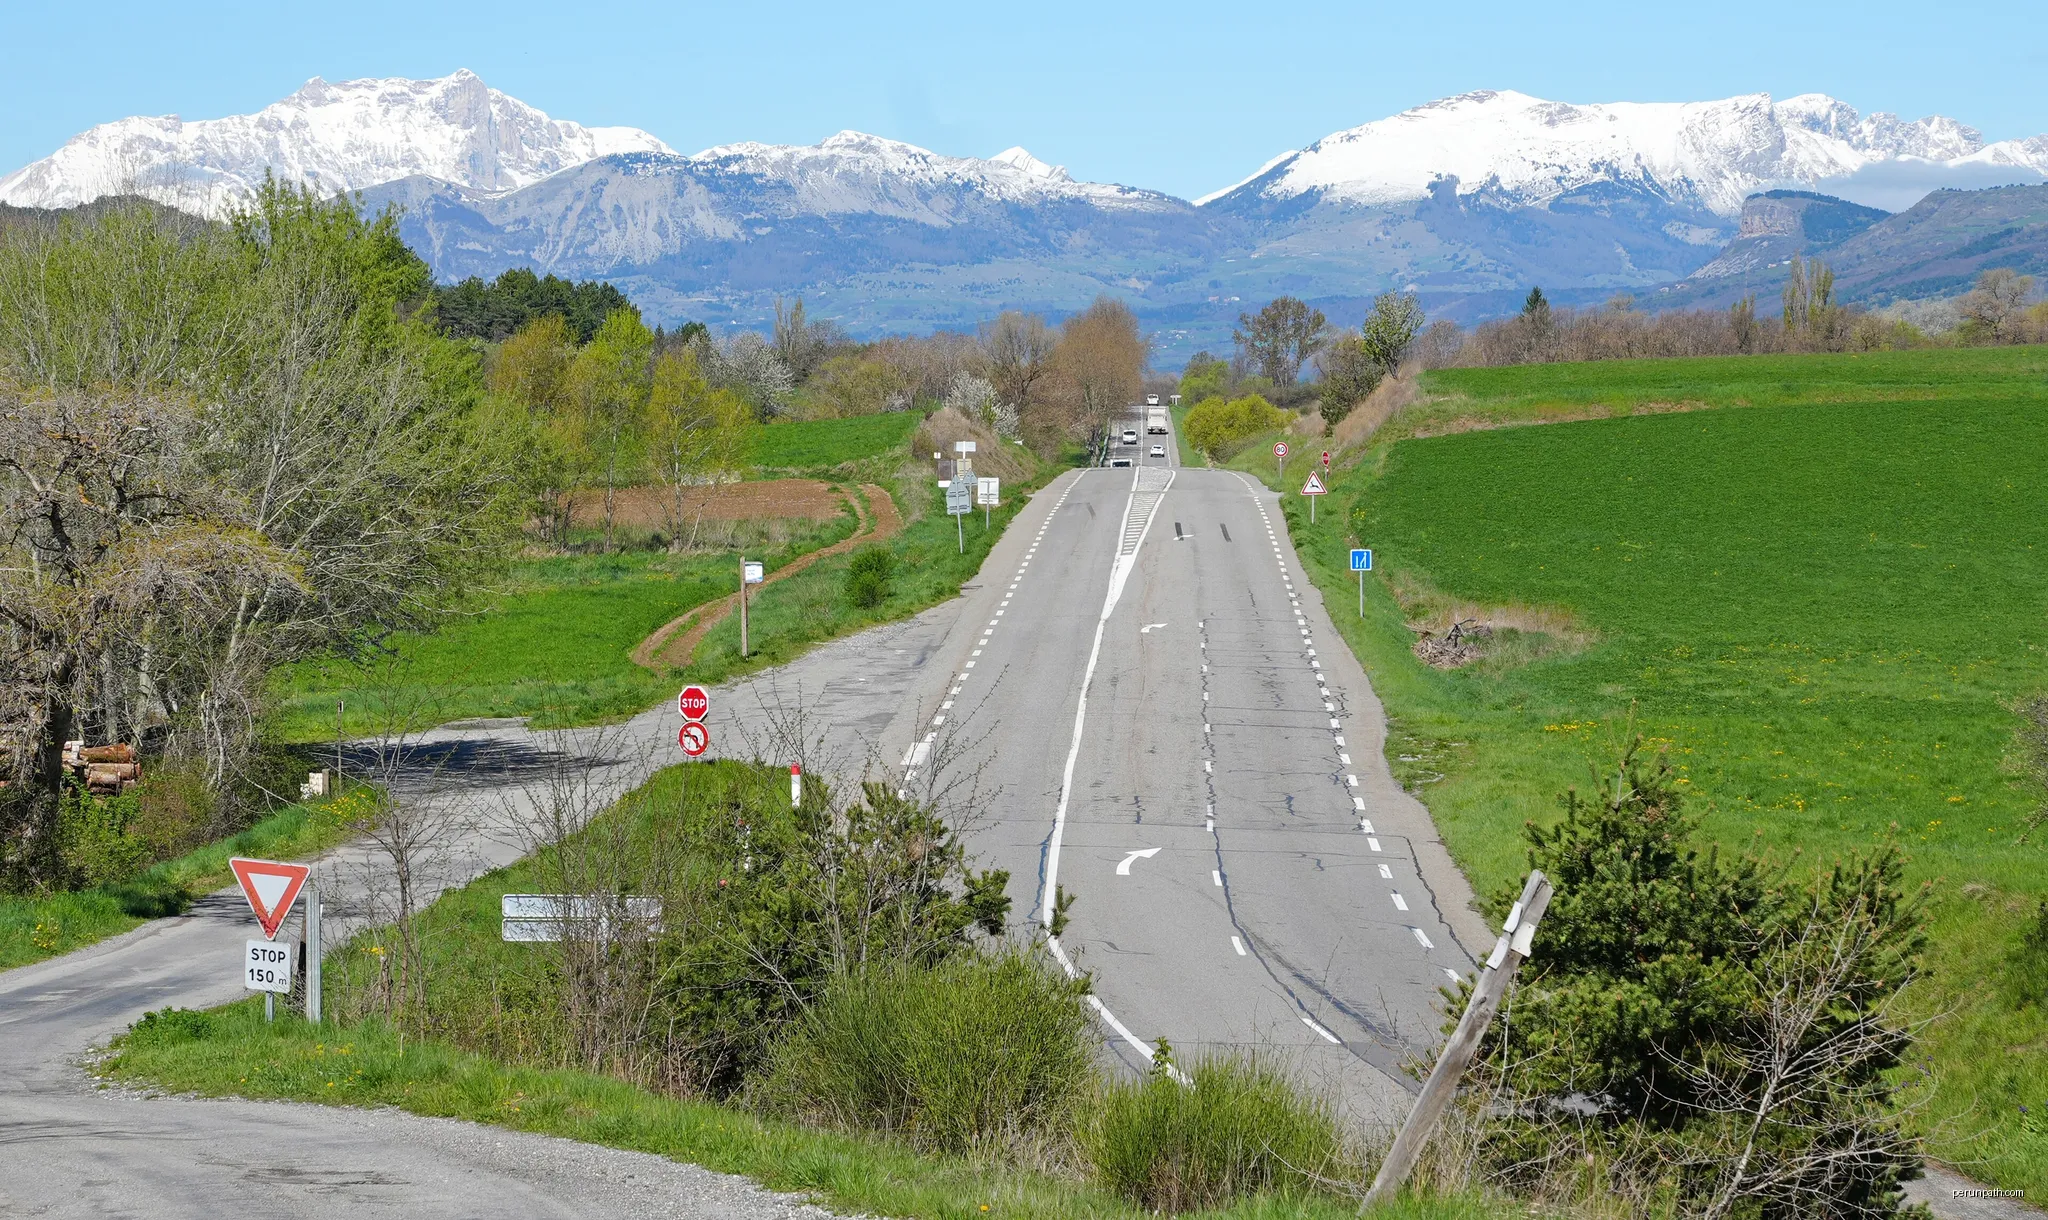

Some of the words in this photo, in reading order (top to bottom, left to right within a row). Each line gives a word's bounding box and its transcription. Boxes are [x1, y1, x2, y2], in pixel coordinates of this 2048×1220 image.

[681, 698, 706, 709] STOP
[251, 948, 286, 963] STOP
[249, 968, 274, 983] 150
